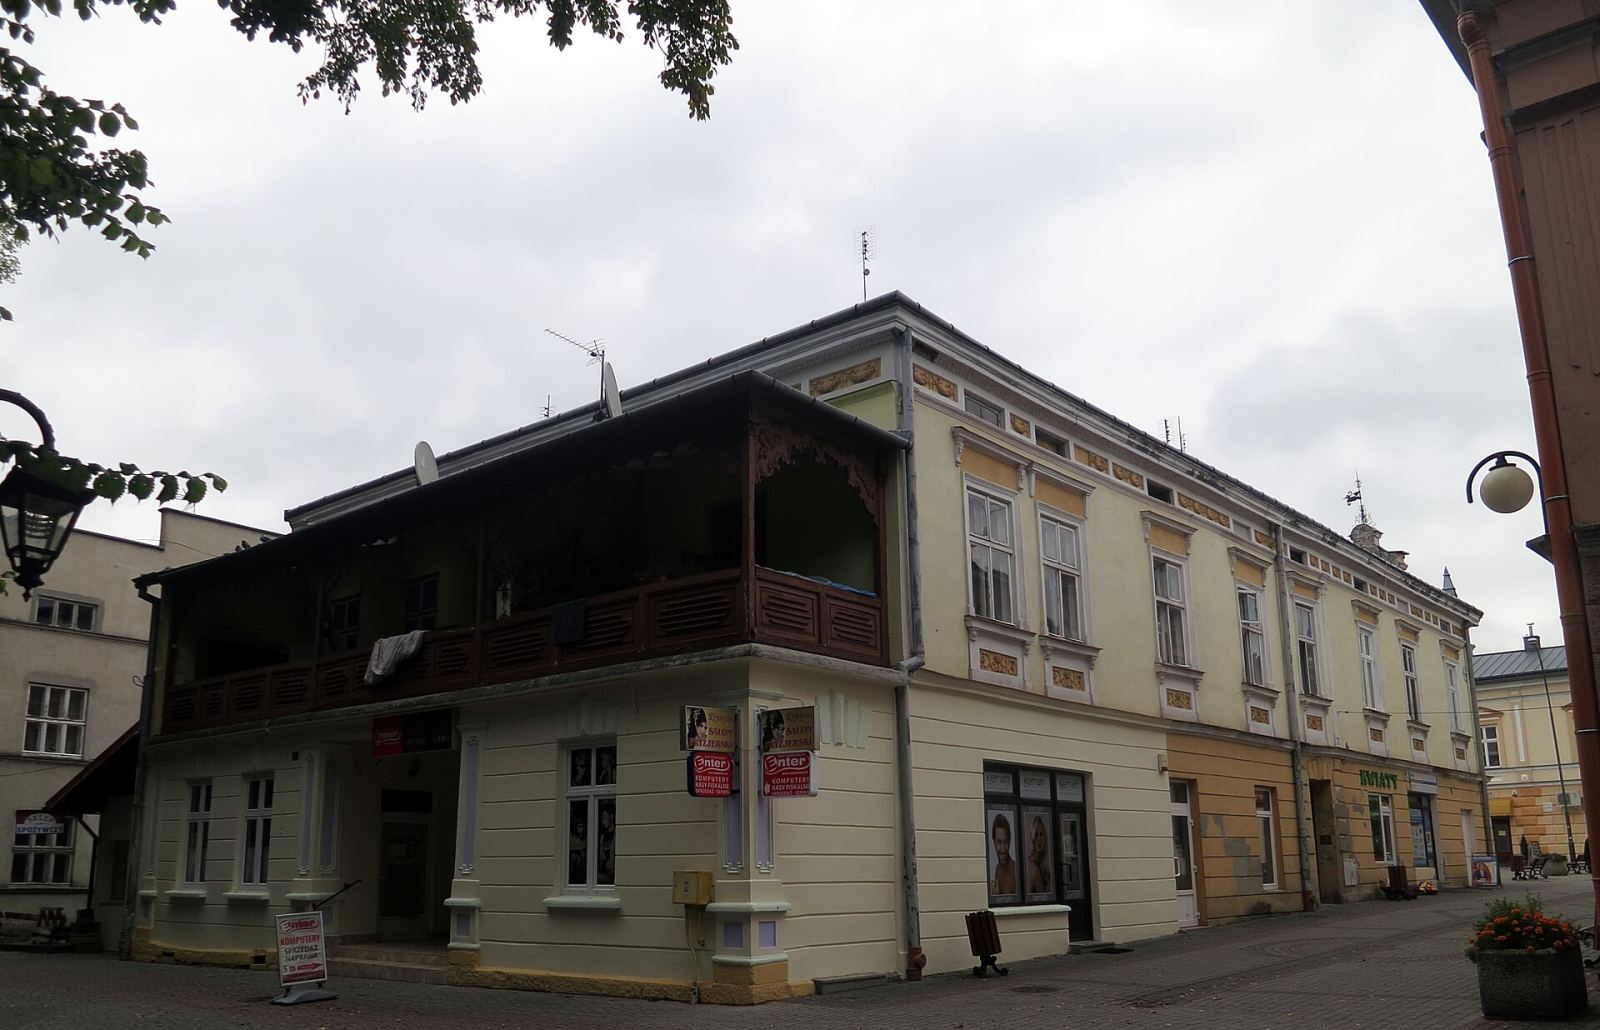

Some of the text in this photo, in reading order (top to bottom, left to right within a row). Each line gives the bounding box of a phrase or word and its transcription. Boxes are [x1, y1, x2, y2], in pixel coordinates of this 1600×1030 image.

[694, 755, 726, 770] Enter
[764, 755, 806, 772] Enter
[695, 775, 728, 783] KOMPUTERY
[771, 776, 809, 785] KOMPUTERY
[1360, 769, 1397, 790] KWIATY
[281, 935, 320, 946] KOMPUTERY
